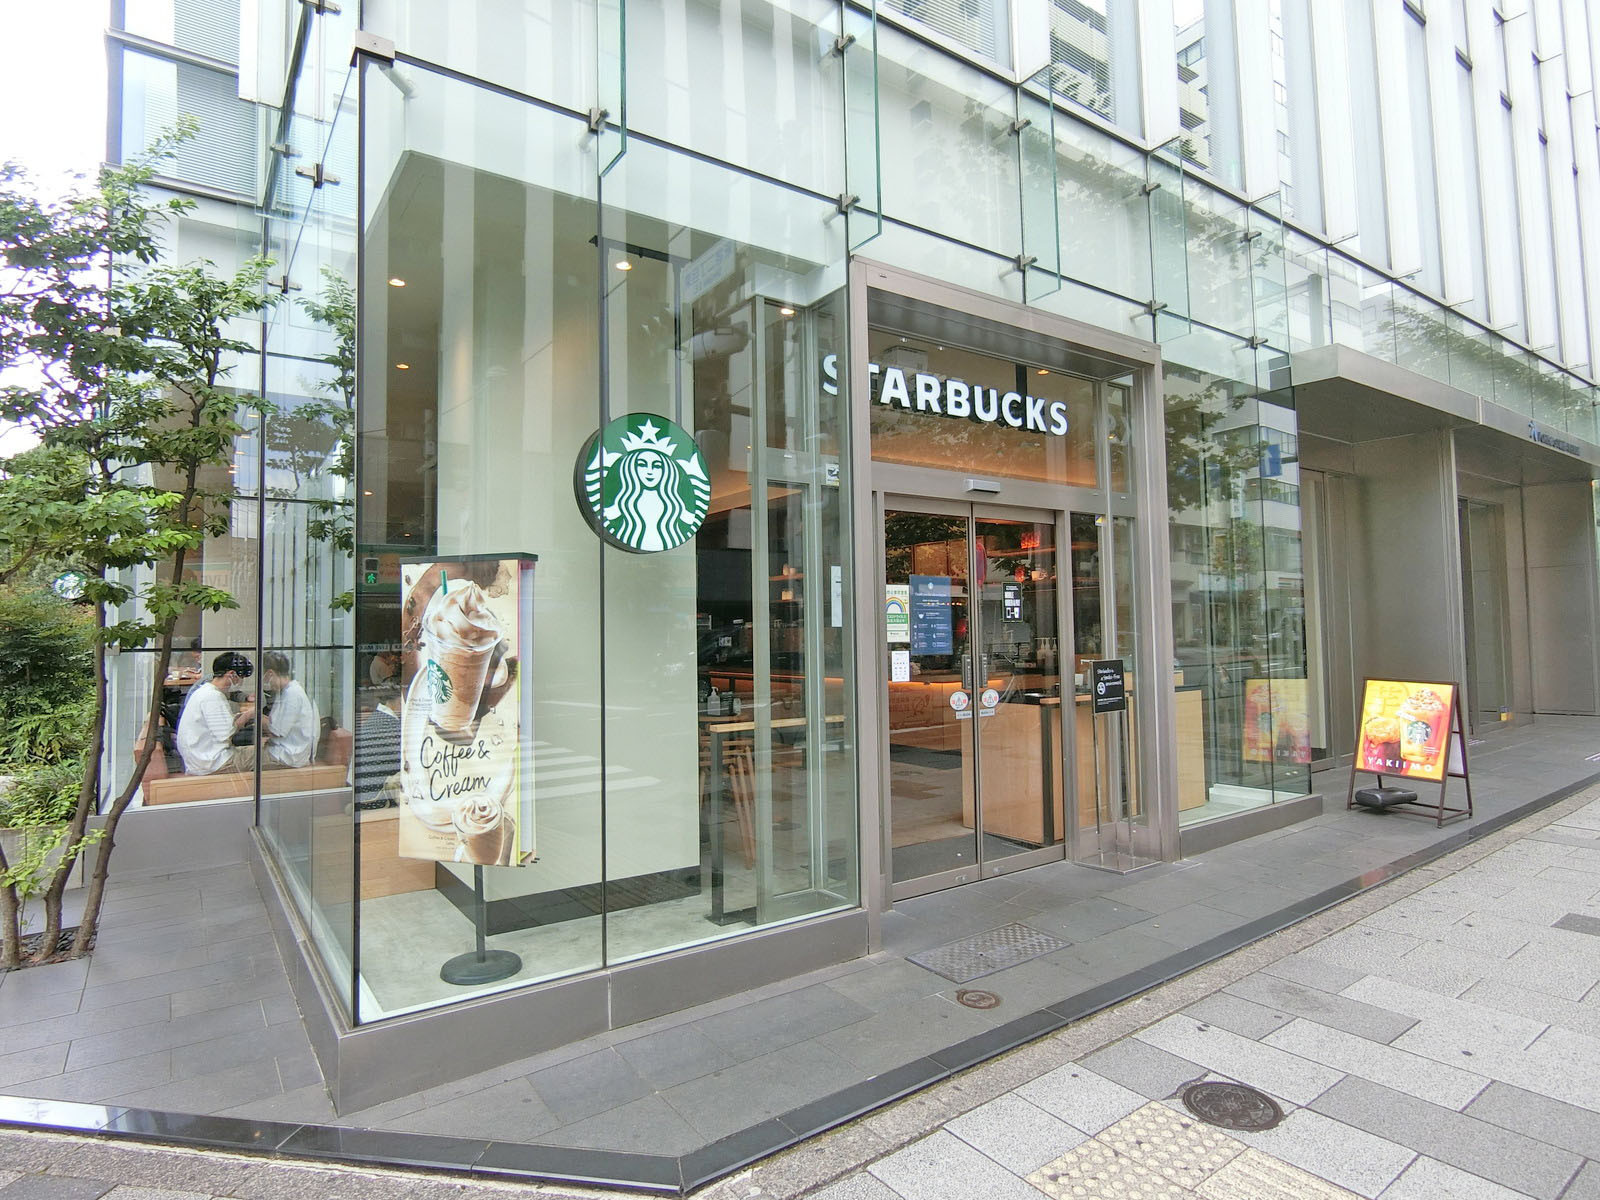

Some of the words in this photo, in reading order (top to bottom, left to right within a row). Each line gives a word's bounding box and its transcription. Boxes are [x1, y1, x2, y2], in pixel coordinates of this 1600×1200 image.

[420, 736, 475, 778] Coffee
[478, 740, 490, 760] &
[430, 769, 491, 802] Cream
